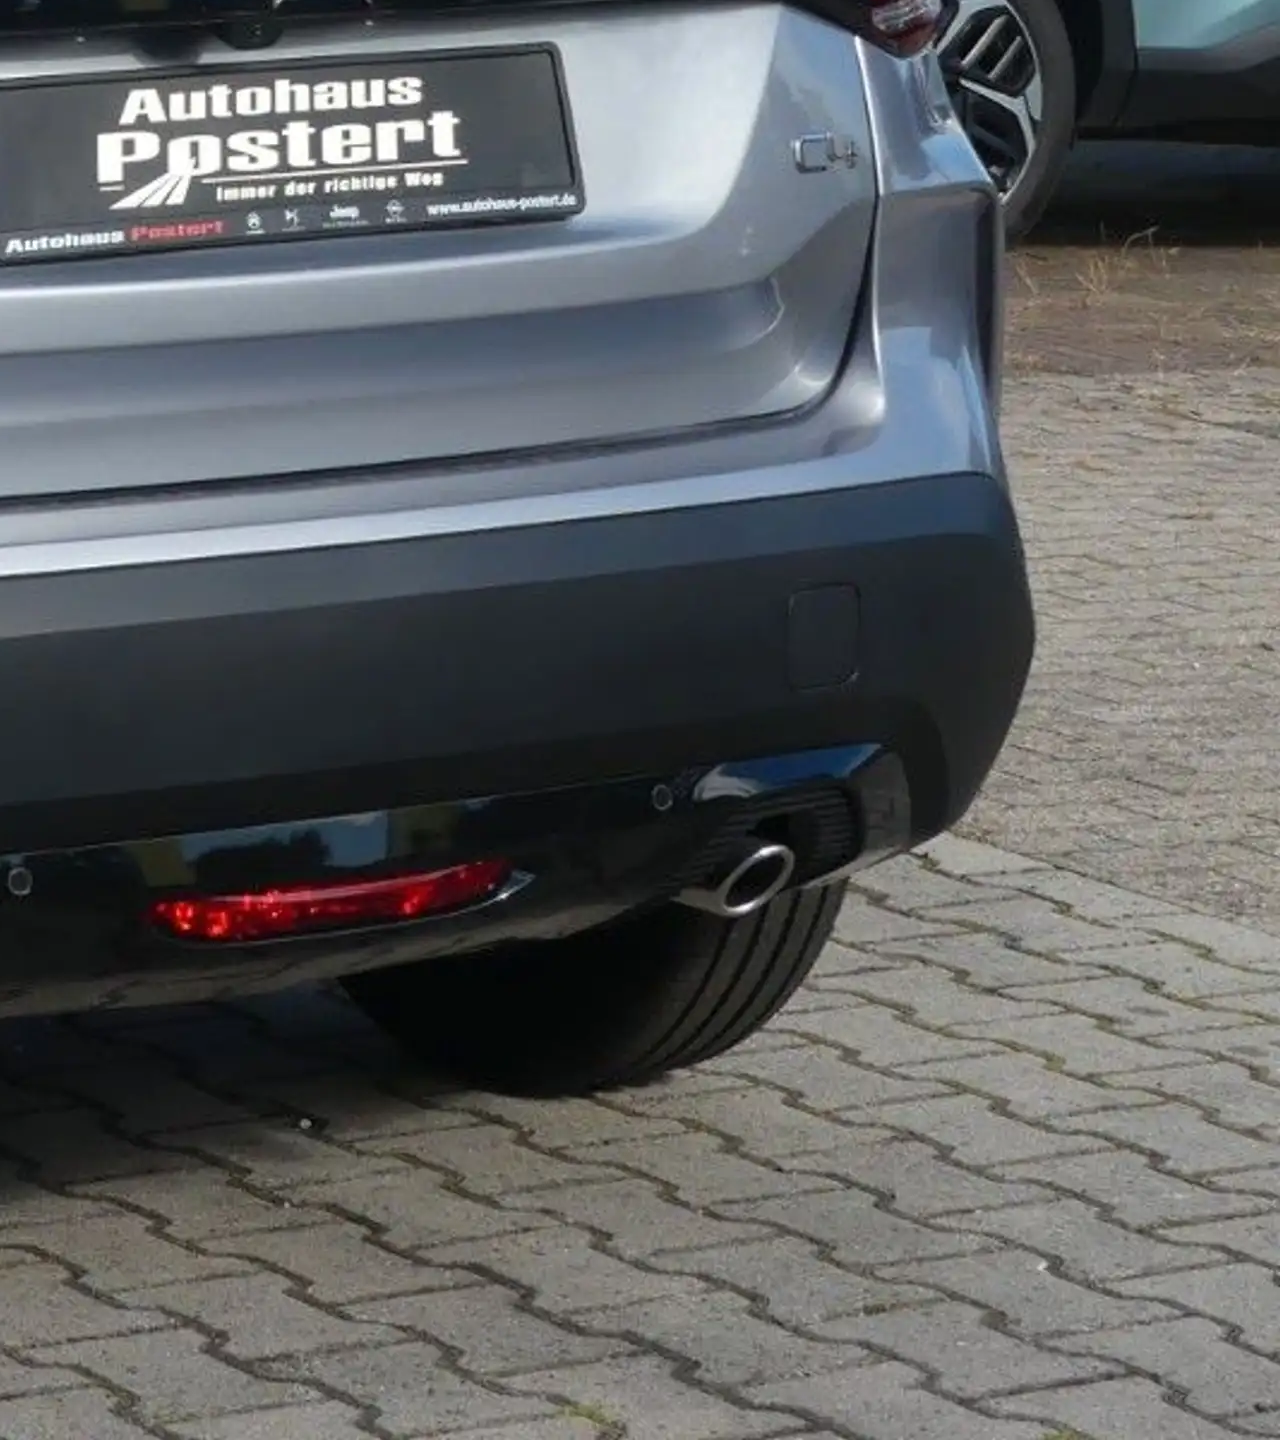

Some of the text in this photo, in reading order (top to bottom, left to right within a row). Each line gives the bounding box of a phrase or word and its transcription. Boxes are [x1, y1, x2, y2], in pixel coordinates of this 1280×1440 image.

[119, 75, 423, 126] Autohaus
[96, 109, 462, 186] Postert
[216, 184, 277, 203] Immer
[284, 180, 317, 197] der
[324, 174, 398, 194] richtige
[4, 229, 126, 254] Autohaus
[130, 220, 225, 242] Postert
